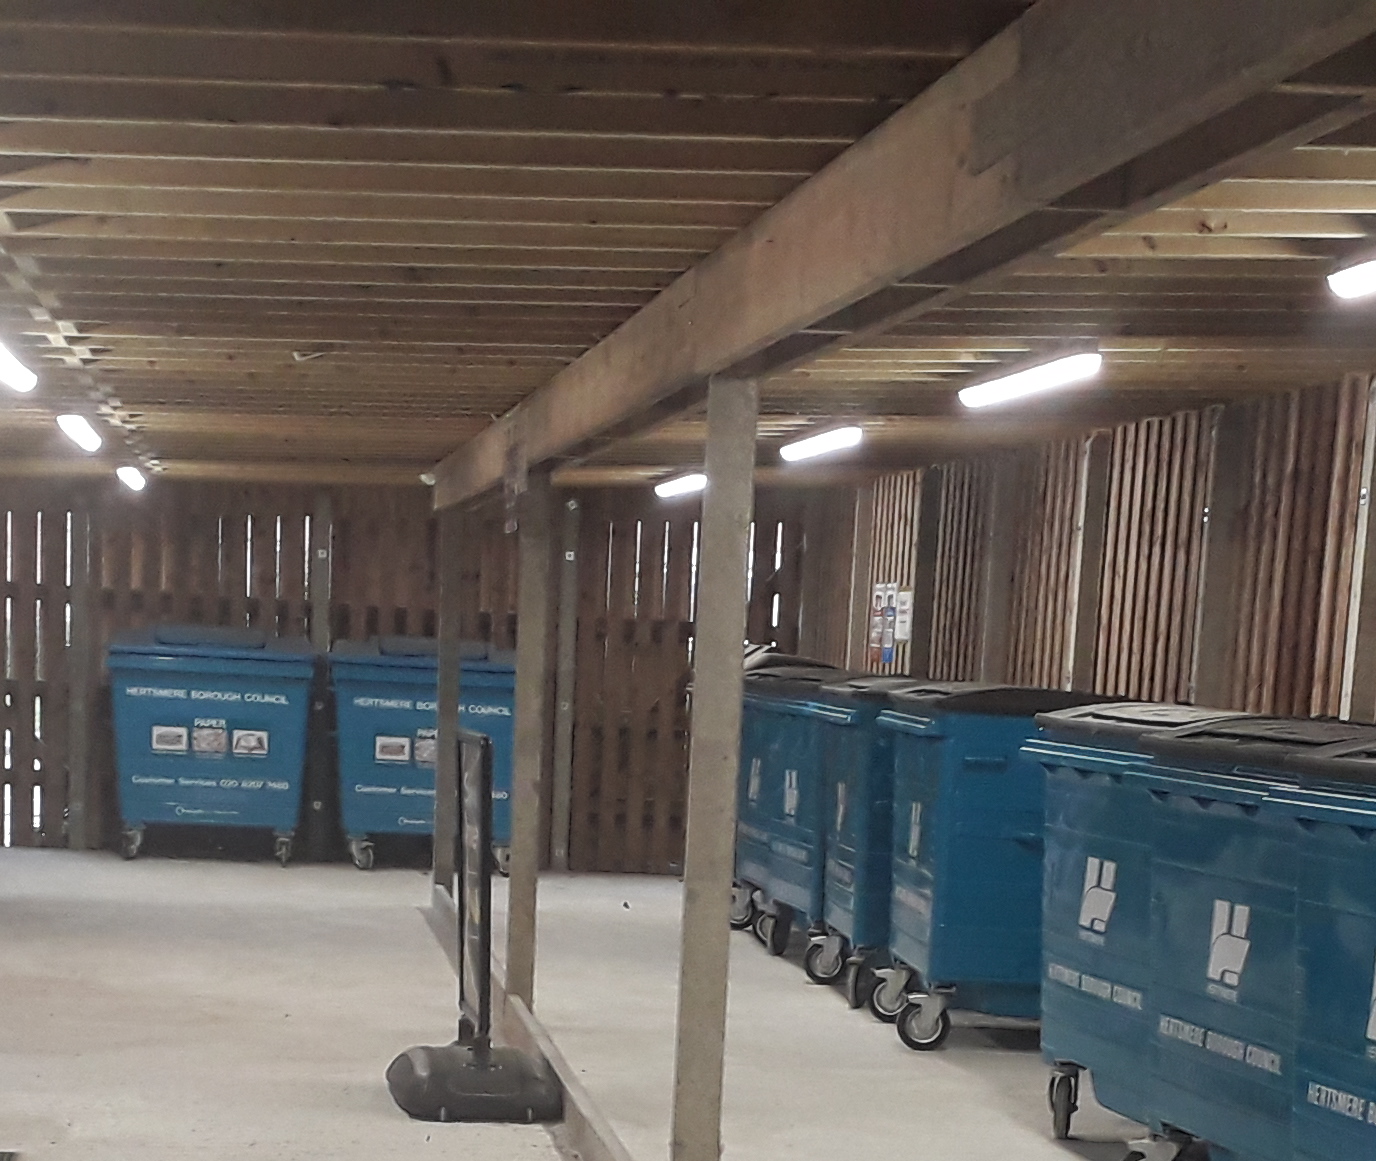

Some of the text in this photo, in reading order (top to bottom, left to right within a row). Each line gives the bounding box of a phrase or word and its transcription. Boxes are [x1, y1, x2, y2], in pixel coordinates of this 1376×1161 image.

[190, 690, 242, 701] BOROUGH
[244, 692, 289, 705] COUNCIL
[1307, 1081, 1367, 1121] HERTSMERE
